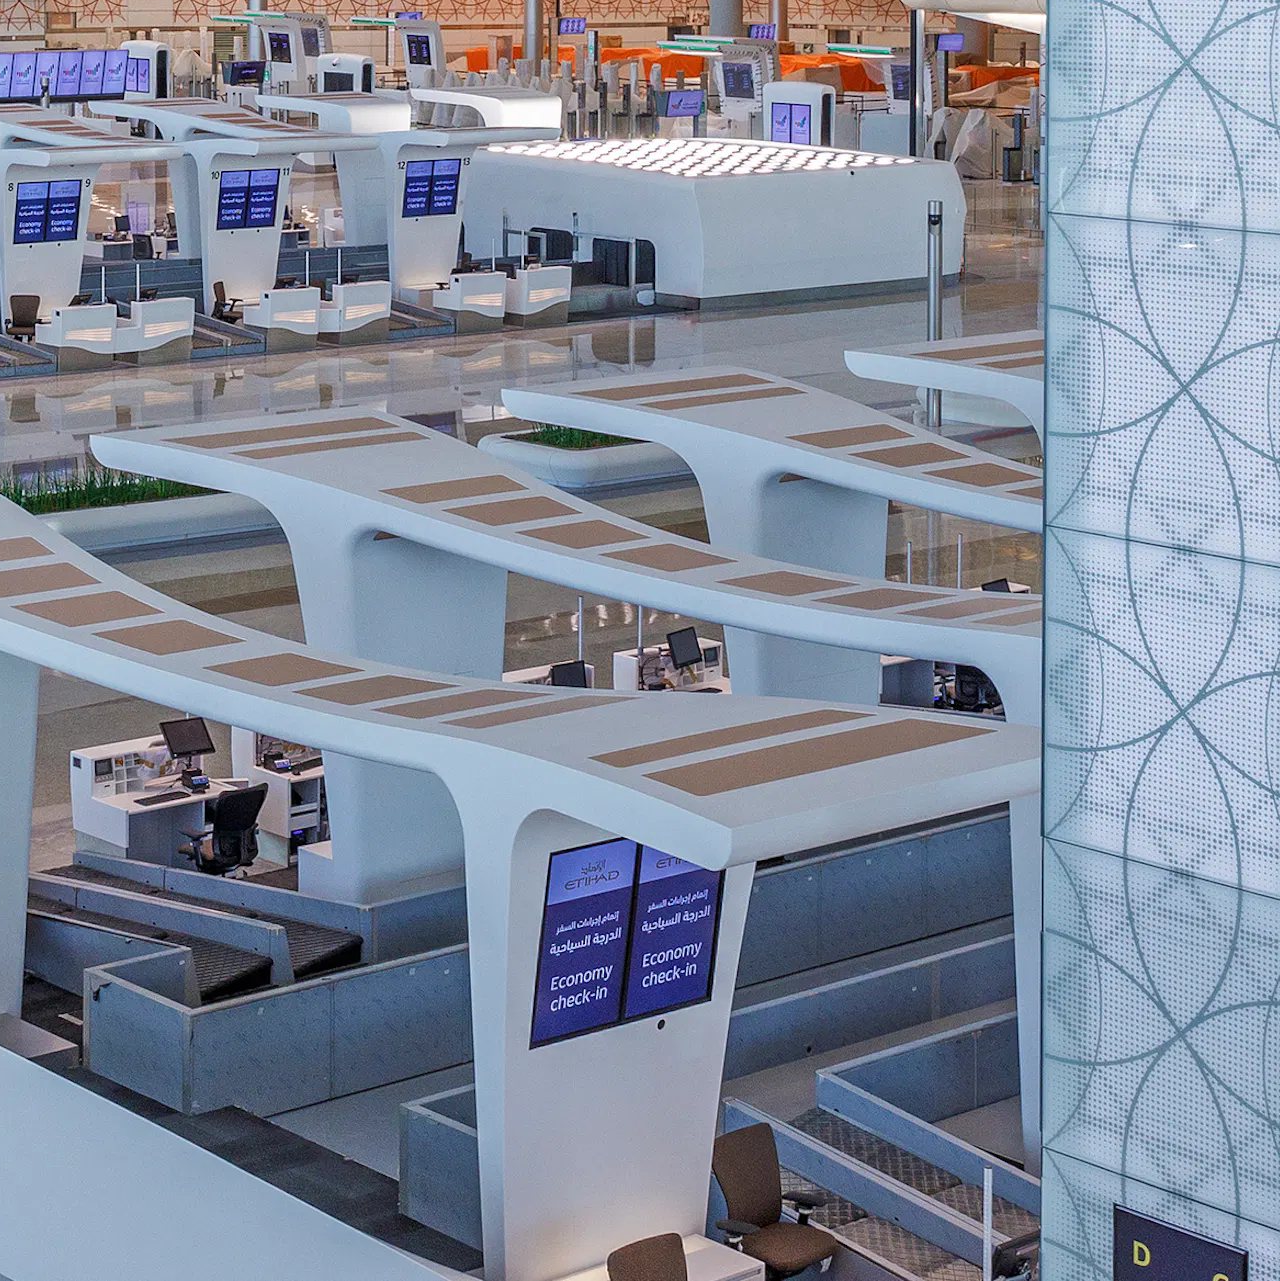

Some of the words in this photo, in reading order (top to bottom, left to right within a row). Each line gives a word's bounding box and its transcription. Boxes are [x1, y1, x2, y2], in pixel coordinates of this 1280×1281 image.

[397, 161, 406, 170] 12
[463, 157, 471, 166] 13
[211, 171, 220, 180] 10
[283, 167, 290, 176] 11
[8, 182, 14, 192] 8
[85, 178, 91, 187] 9
[564, 870, 620, 890] ETIHAD
[641, 912, 681, 934] السياحية
[682, 904, 711, 923] الدرجة
[549, 934, 591, 956] السياحية
[592, 927, 622, 946] الدرجة
[642, 942, 702, 968] Economy
[550, 965, 613, 992] Economy
[642, 963, 697, 988] check-in
[550, 985, 608, 1012] check-in
[1133, 1240, 1151, 1267] D
